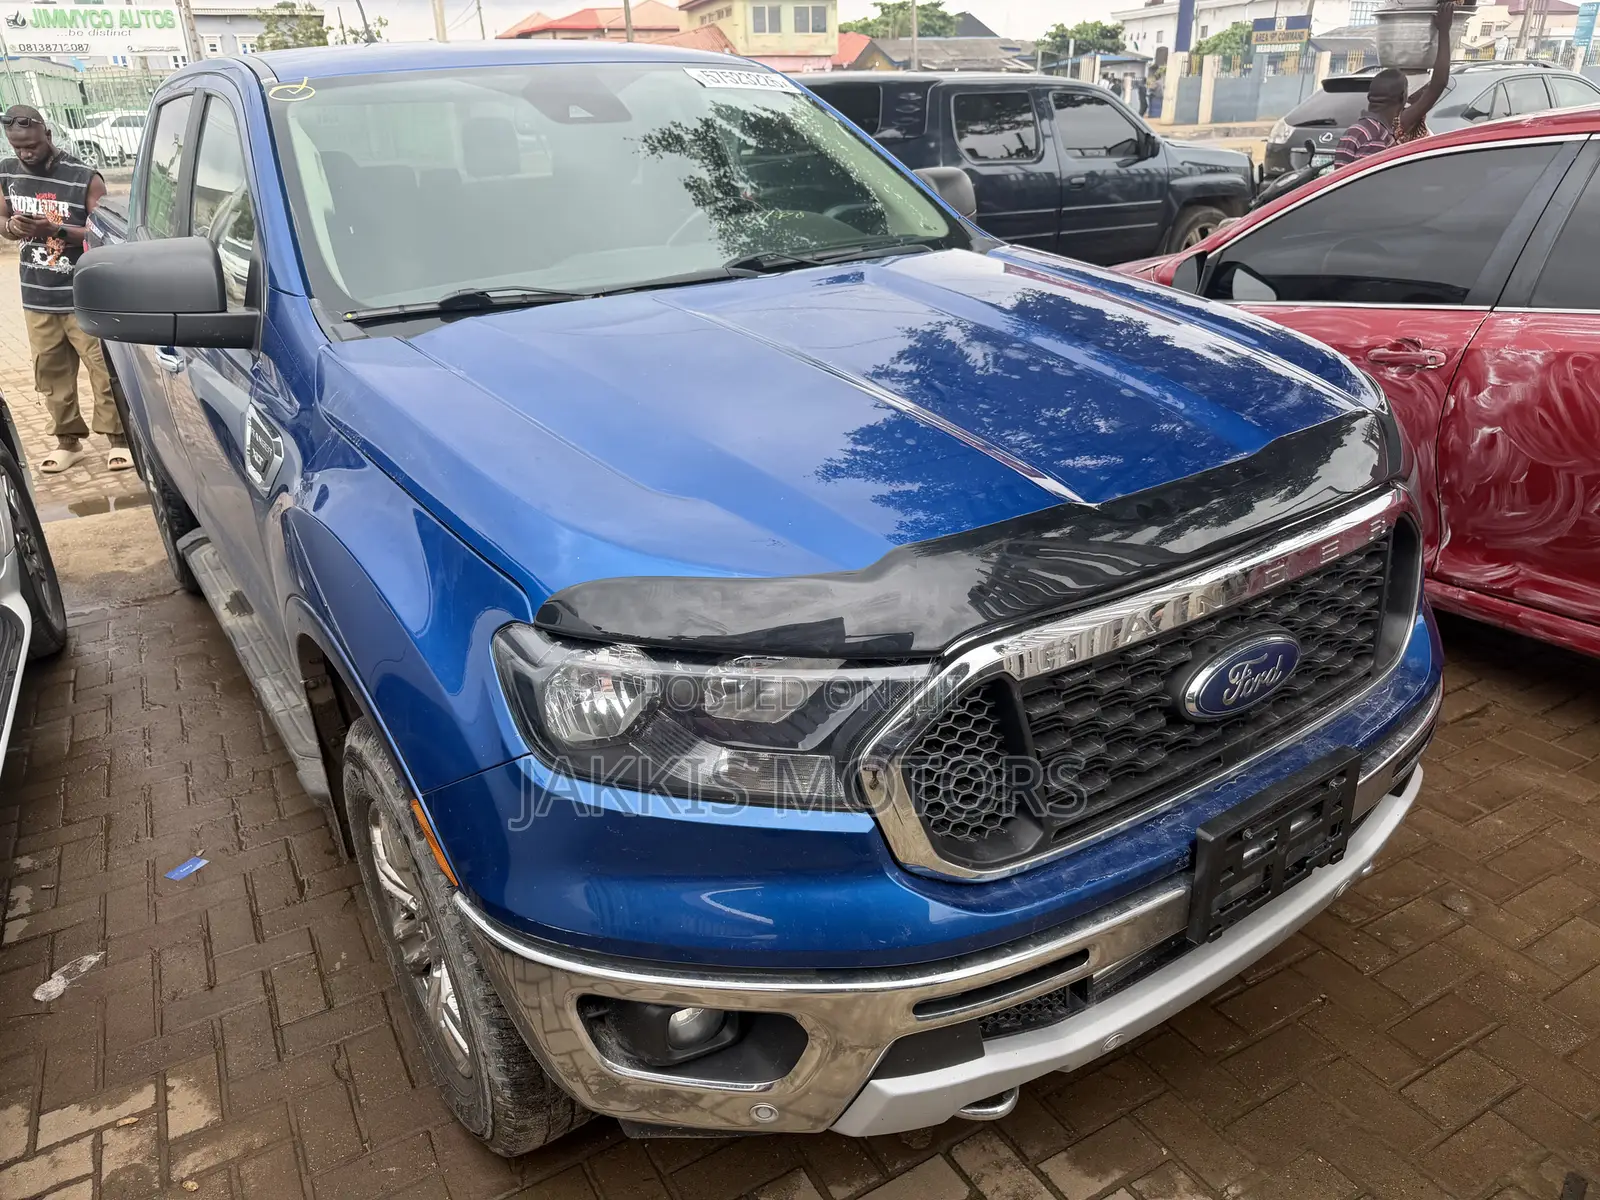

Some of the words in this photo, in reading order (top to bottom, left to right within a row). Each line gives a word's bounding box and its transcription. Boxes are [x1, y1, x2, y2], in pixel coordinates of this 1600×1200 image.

[29, 8, 114, 29] JIMMYCO
[119, 9, 176, 29] AUTOS
[88, 29, 132, 37] distinct
[1222, 652, 1283, 706] Ford
